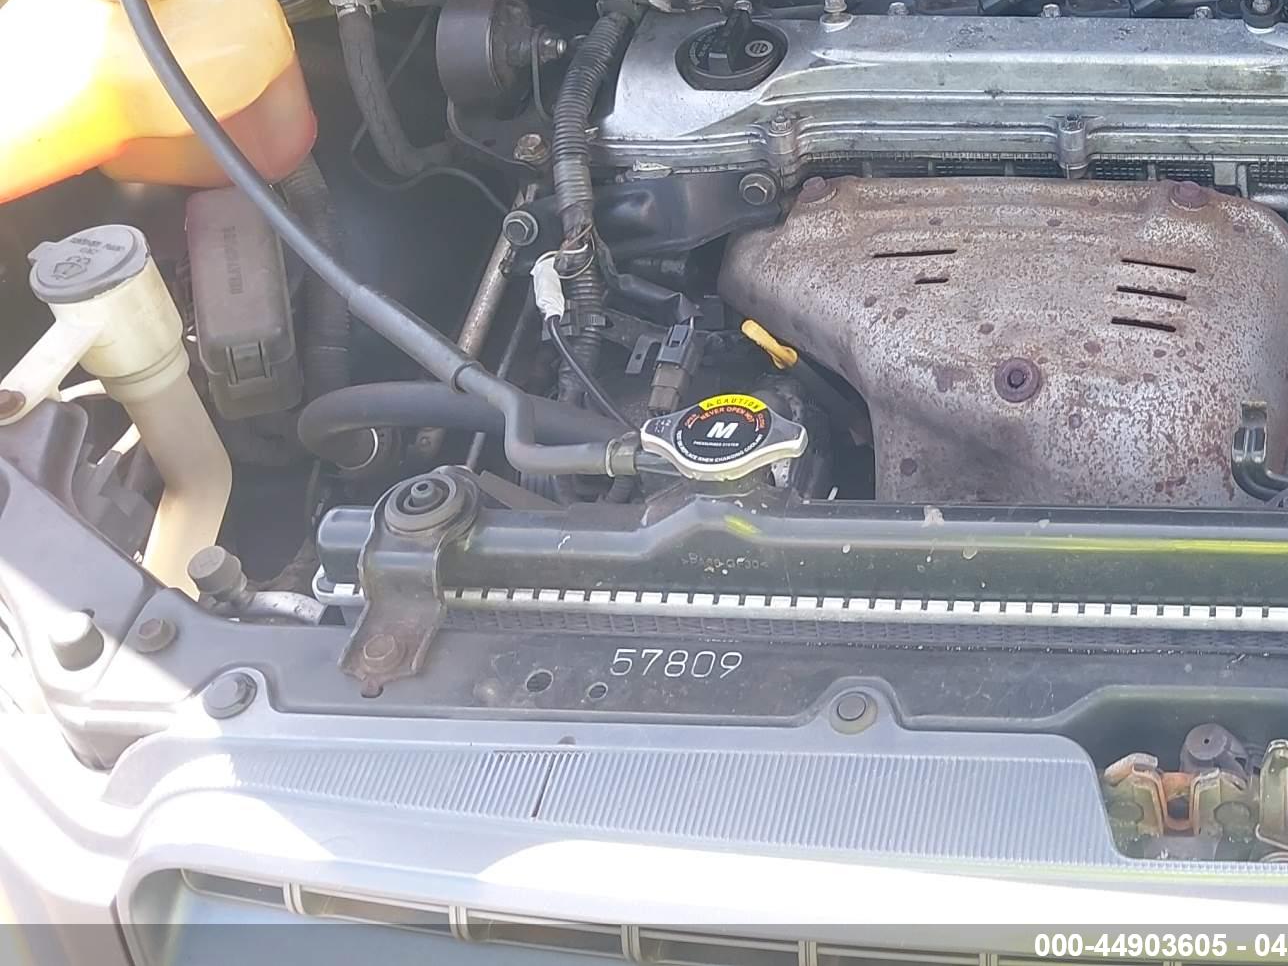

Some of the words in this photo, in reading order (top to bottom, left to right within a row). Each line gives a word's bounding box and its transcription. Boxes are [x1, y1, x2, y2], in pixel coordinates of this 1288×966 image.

[716, 398, 760, 409] CAUTION
[699, 407, 725, 421] NEVER
[726, 406, 746, 415] OPEN
[706, 421, 739, 439] M
[609, 648, 744, 679] 57809
